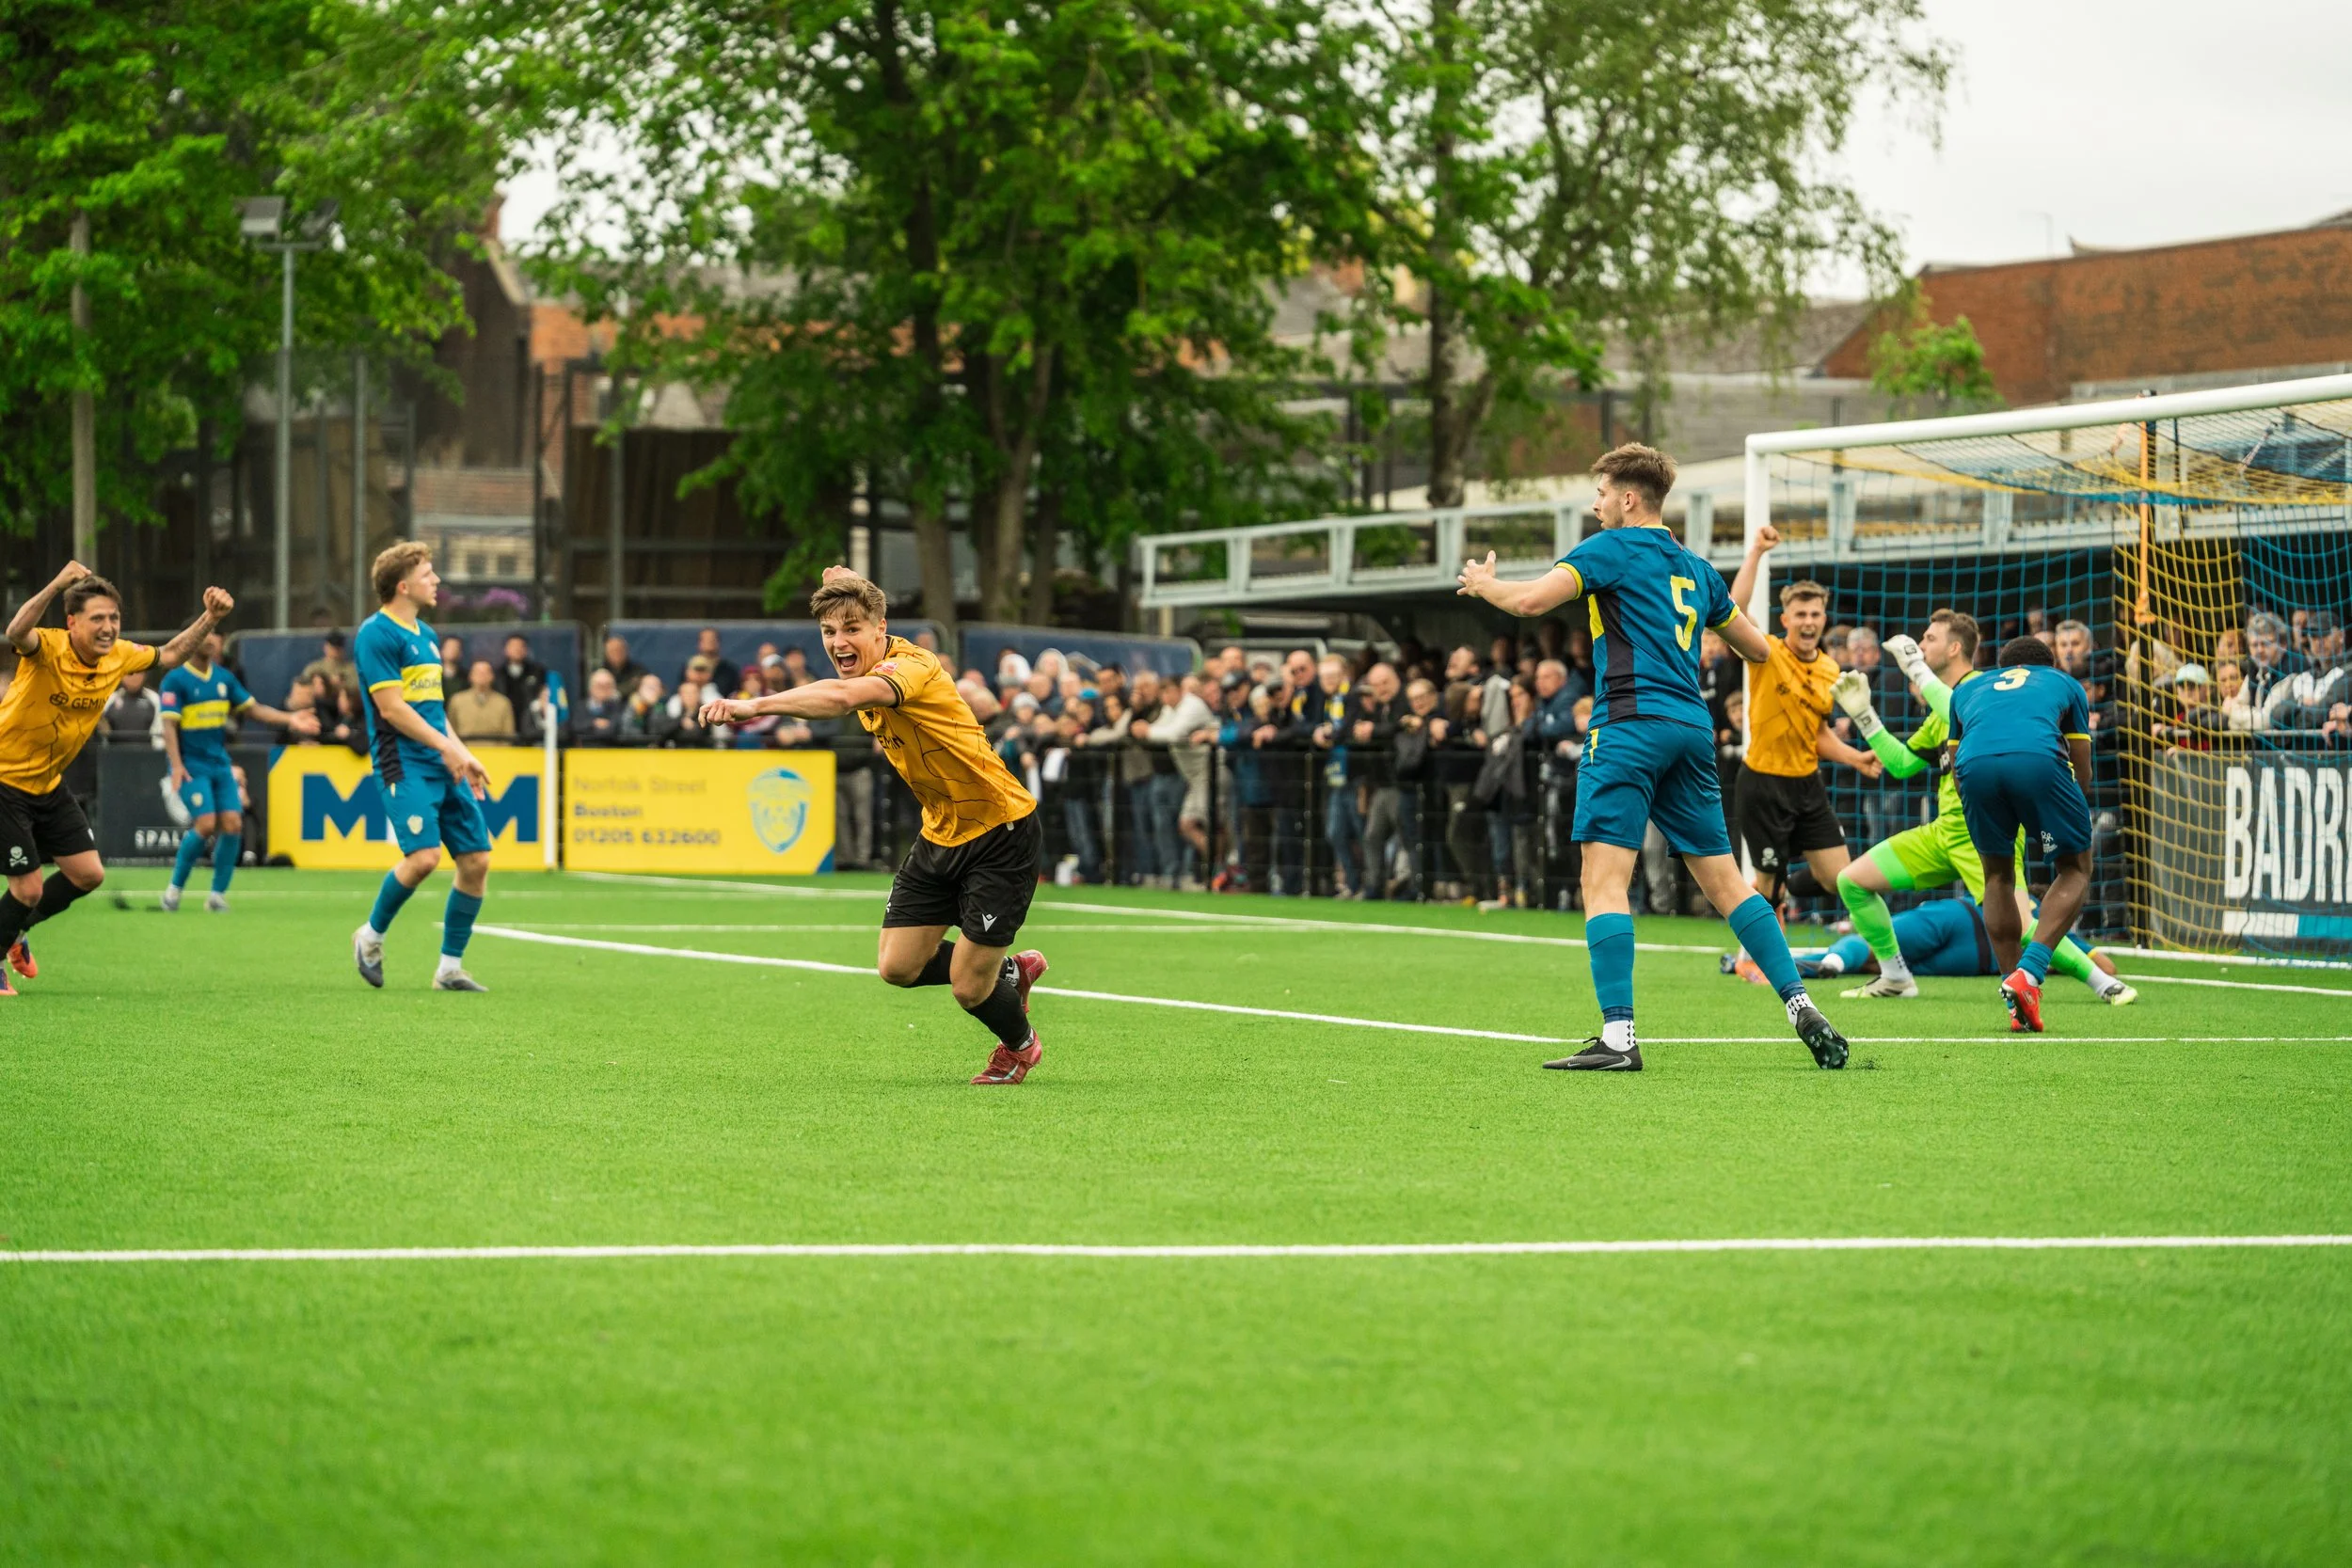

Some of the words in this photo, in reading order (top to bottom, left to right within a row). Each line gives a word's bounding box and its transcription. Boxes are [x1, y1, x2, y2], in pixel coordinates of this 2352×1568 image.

[1670, 575, 1697, 651] 5
[1994, 668, 2030, 690] 3
[301, 773, 539, 843] MM
[573, 801, 643, 817] Boston
[135, 830, 189, 848] SPAL
[2224, 767, 2352, 903] BADR
